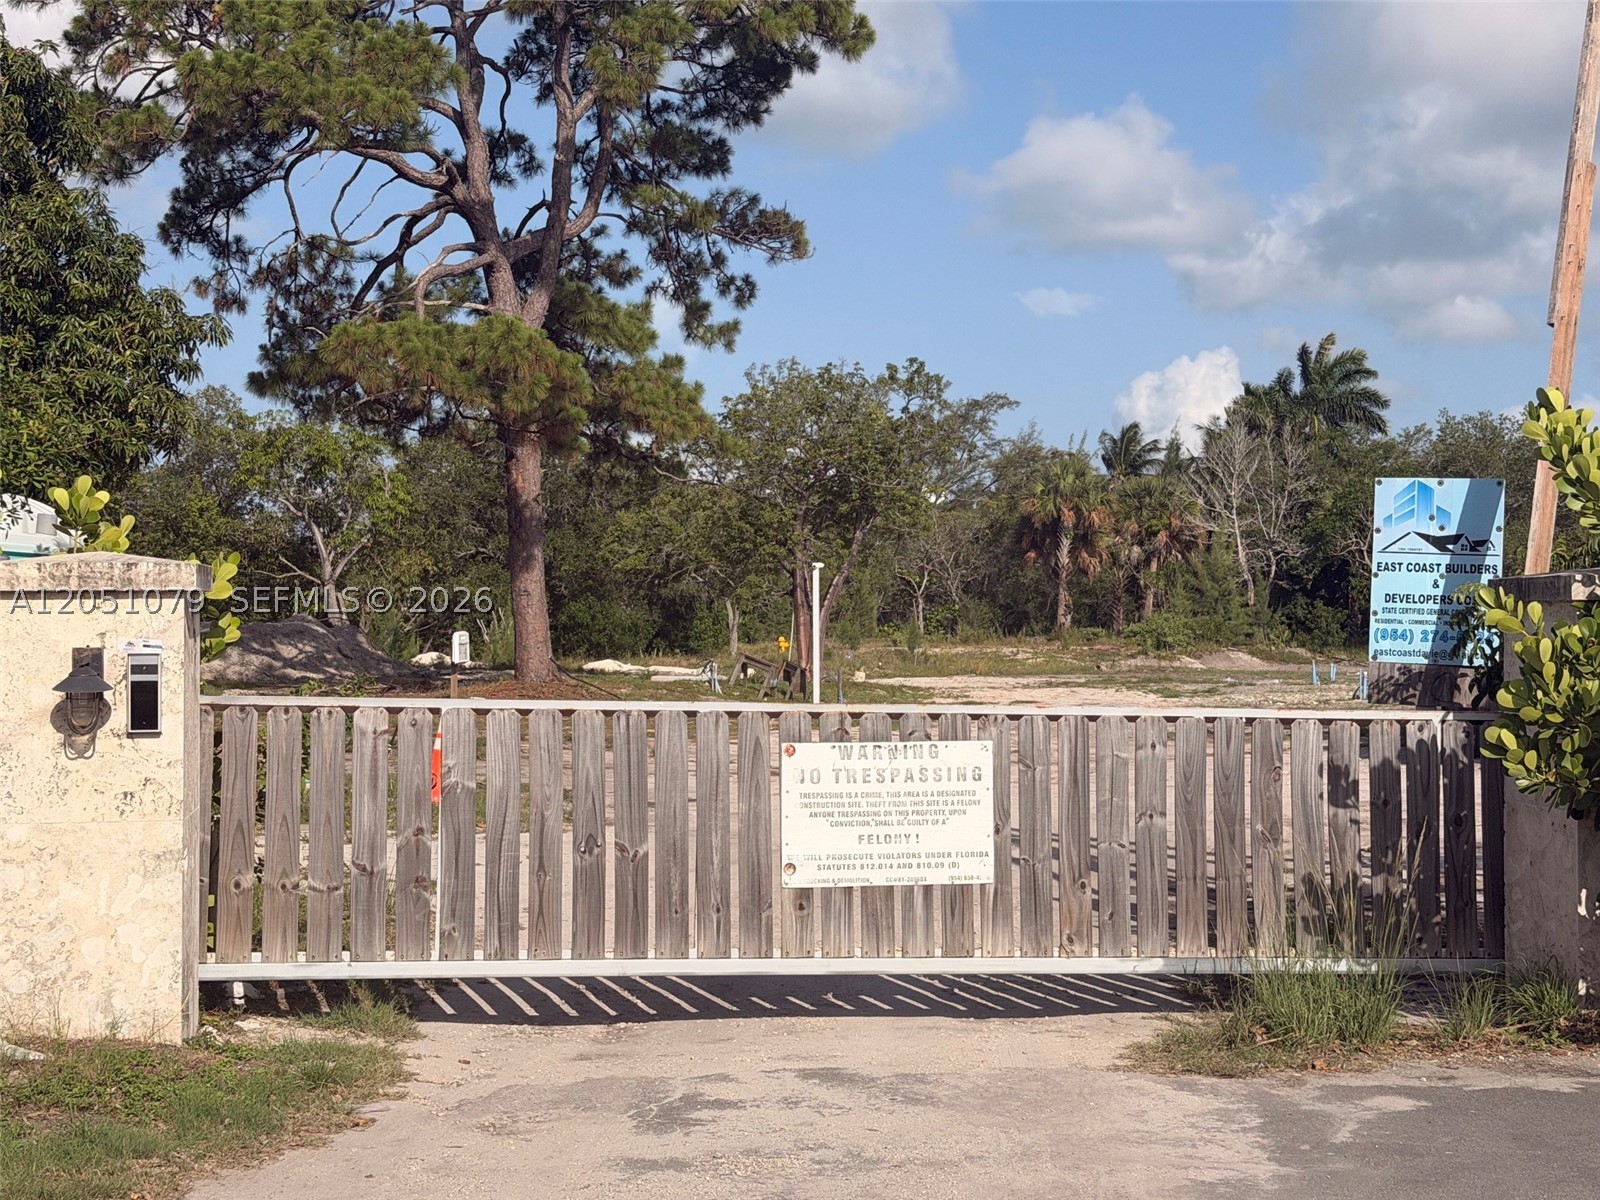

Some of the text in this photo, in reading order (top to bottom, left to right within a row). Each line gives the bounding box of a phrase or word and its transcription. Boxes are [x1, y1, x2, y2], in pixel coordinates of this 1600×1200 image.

[1376, 561, 1498, 575] EAST COAST BUILDERS
[1432, 578, 1440, 589] &
[1384, 593, 1454, 605] DEVELOPERS
[1381, 606, 1398, 615] STATE
[1398, 607, 1425, 616] CERTIFIED
[1426, 608, 1451, 616] GENERAL
[1373, 627, 1415, 645] (954)
[838, 744, 939, 761] WARNING
[832, 766, 982, 784] TRESPASSING
[799, 791, 844, 800] TRESPASSING
[845, 791, 853, 799] IS
[853, 791, 859, 799] A
[886, 791, 902, 799] THIS
[902, 790, 920, 798] AREA
[921, 790, 929, 798] IS
[929, 790, 935, 798] A
[936, 789, 977, 798] DESIGNATED
[865, 800, 887, 808] THEFT
[926, 799, 941, 807] SITE
[941, 799, 949, 807] IS
[950, 799, 956, 807] A
[956, 799, 981, 807] FELONY
[837, 810, 882, 818] TRESPASSING
[894, 809, 910, 817] THIS
[911, 809, 947, 817] PROPERTY,
[931, 818, 940, 826] OF
[826, 852, 874, 861] PROSECUTE
[877, 851, 922, 860] VIOLATORS
[925, 851, 953, 859] UNDER
[955, 850, 990, 859] FLORIDA
[816, 861, 960, 871] STATUTES 812.014 AND 810.09 (D)
[837, 876, 870, 884] DEMOLITION
